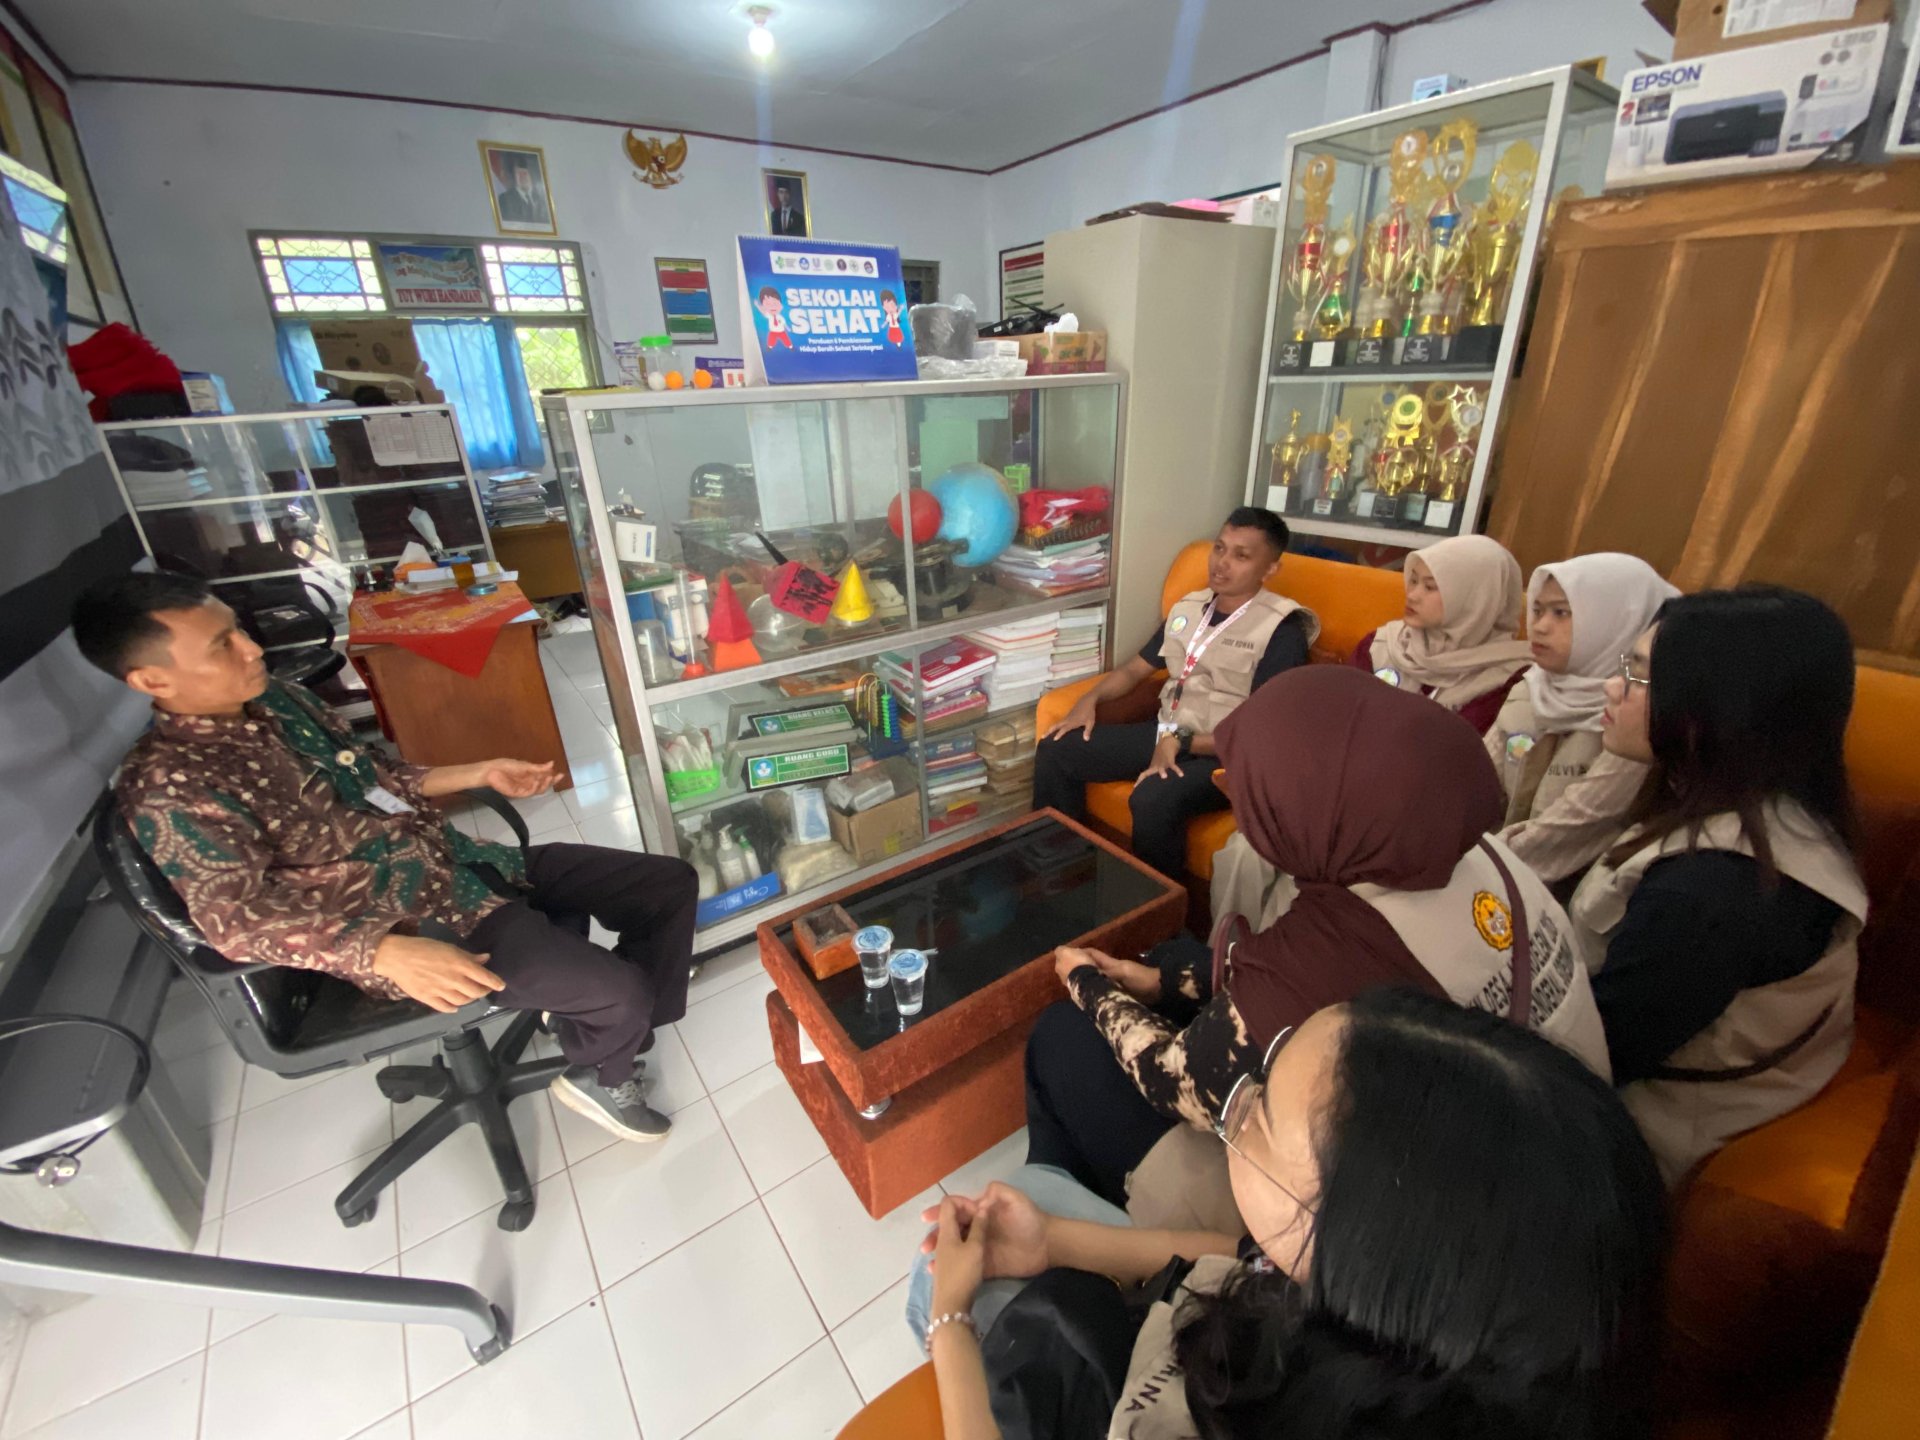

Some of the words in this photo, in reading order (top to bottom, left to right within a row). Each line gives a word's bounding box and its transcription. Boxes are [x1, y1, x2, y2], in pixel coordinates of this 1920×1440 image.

[1632, 64, 1703, 92] EPSON
[785, 288, 877, 307] SEKOLAH
[788, 309, 881, 334] SEHAT
[784, 752, 814, 762] RUANG
[816, 748, 839, 758] GURU
